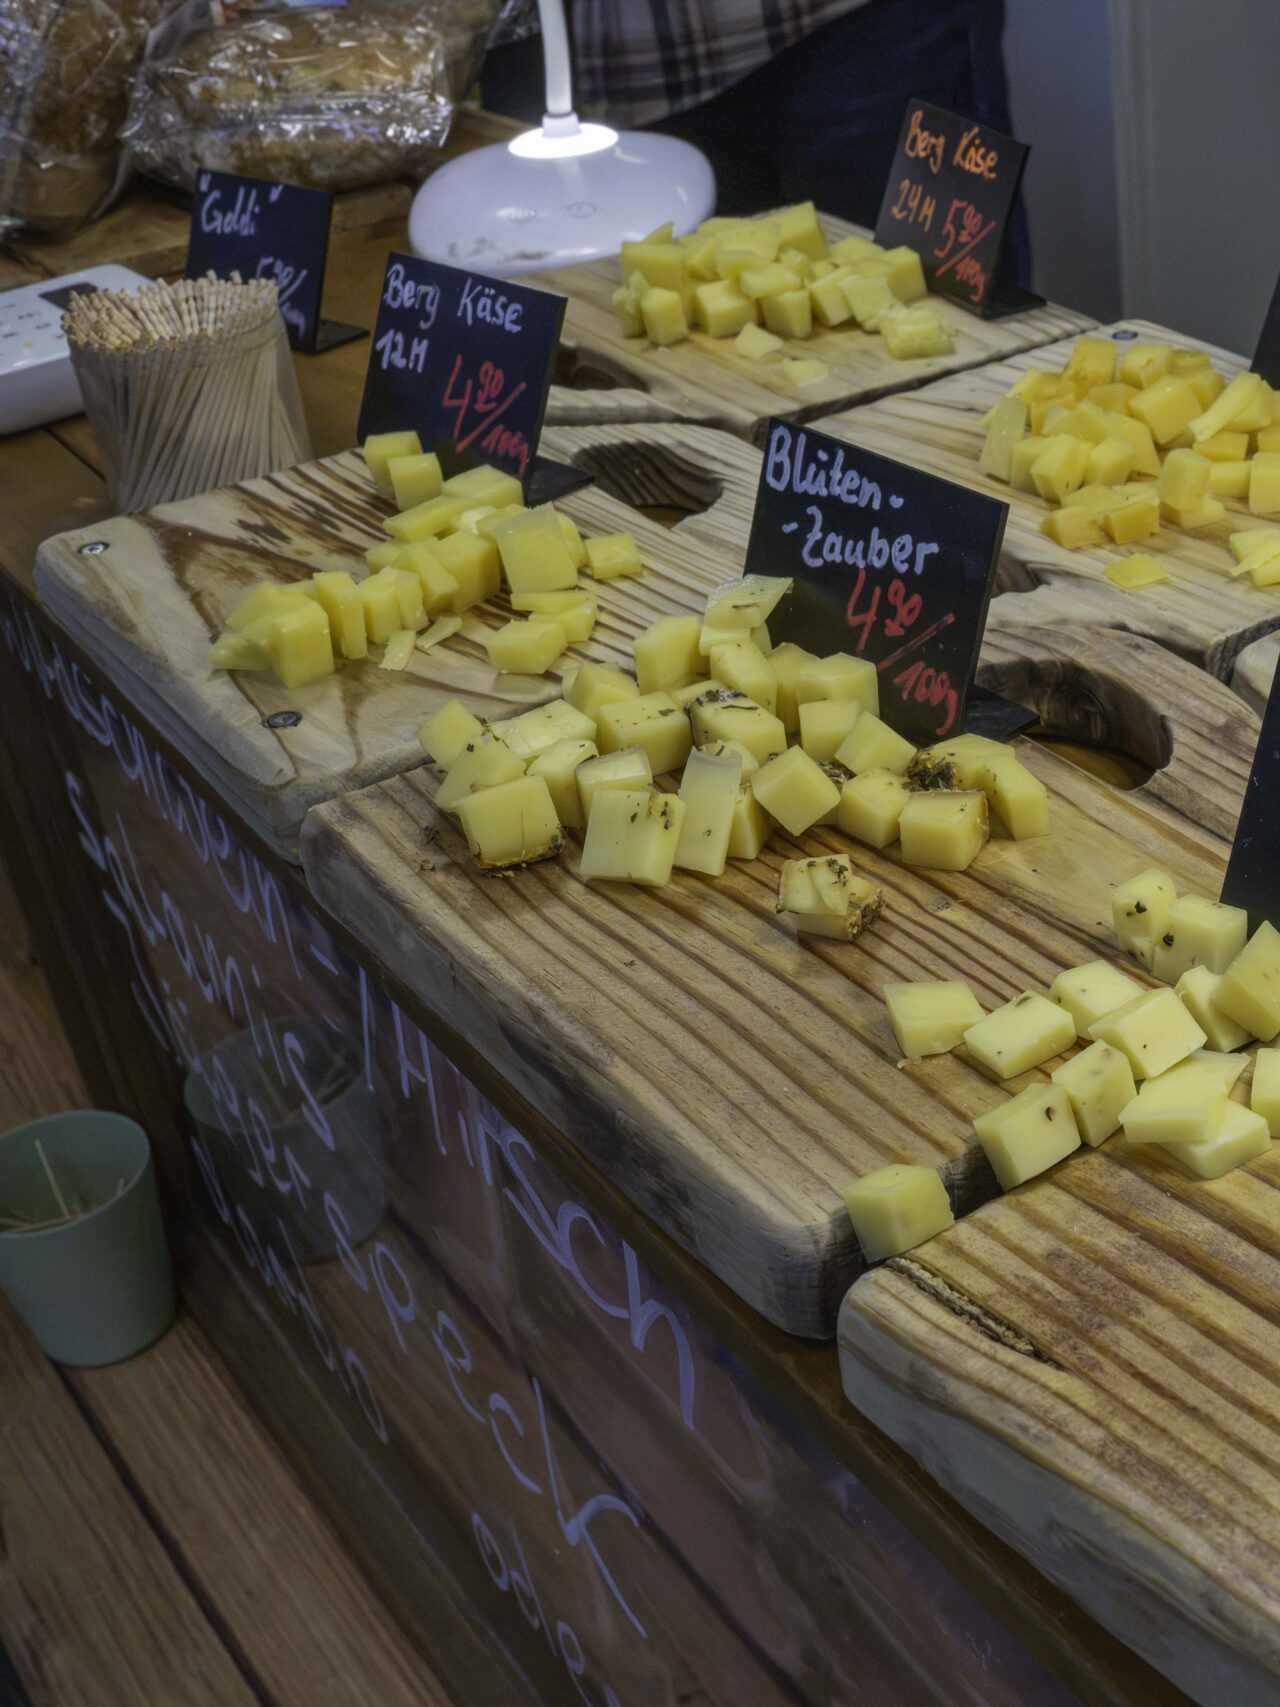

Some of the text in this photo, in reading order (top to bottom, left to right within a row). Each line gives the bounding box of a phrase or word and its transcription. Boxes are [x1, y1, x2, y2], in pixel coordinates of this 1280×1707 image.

[904, 110, 997, 179] Berg Käse
[383, 263, 523, 333] Berg Käse
